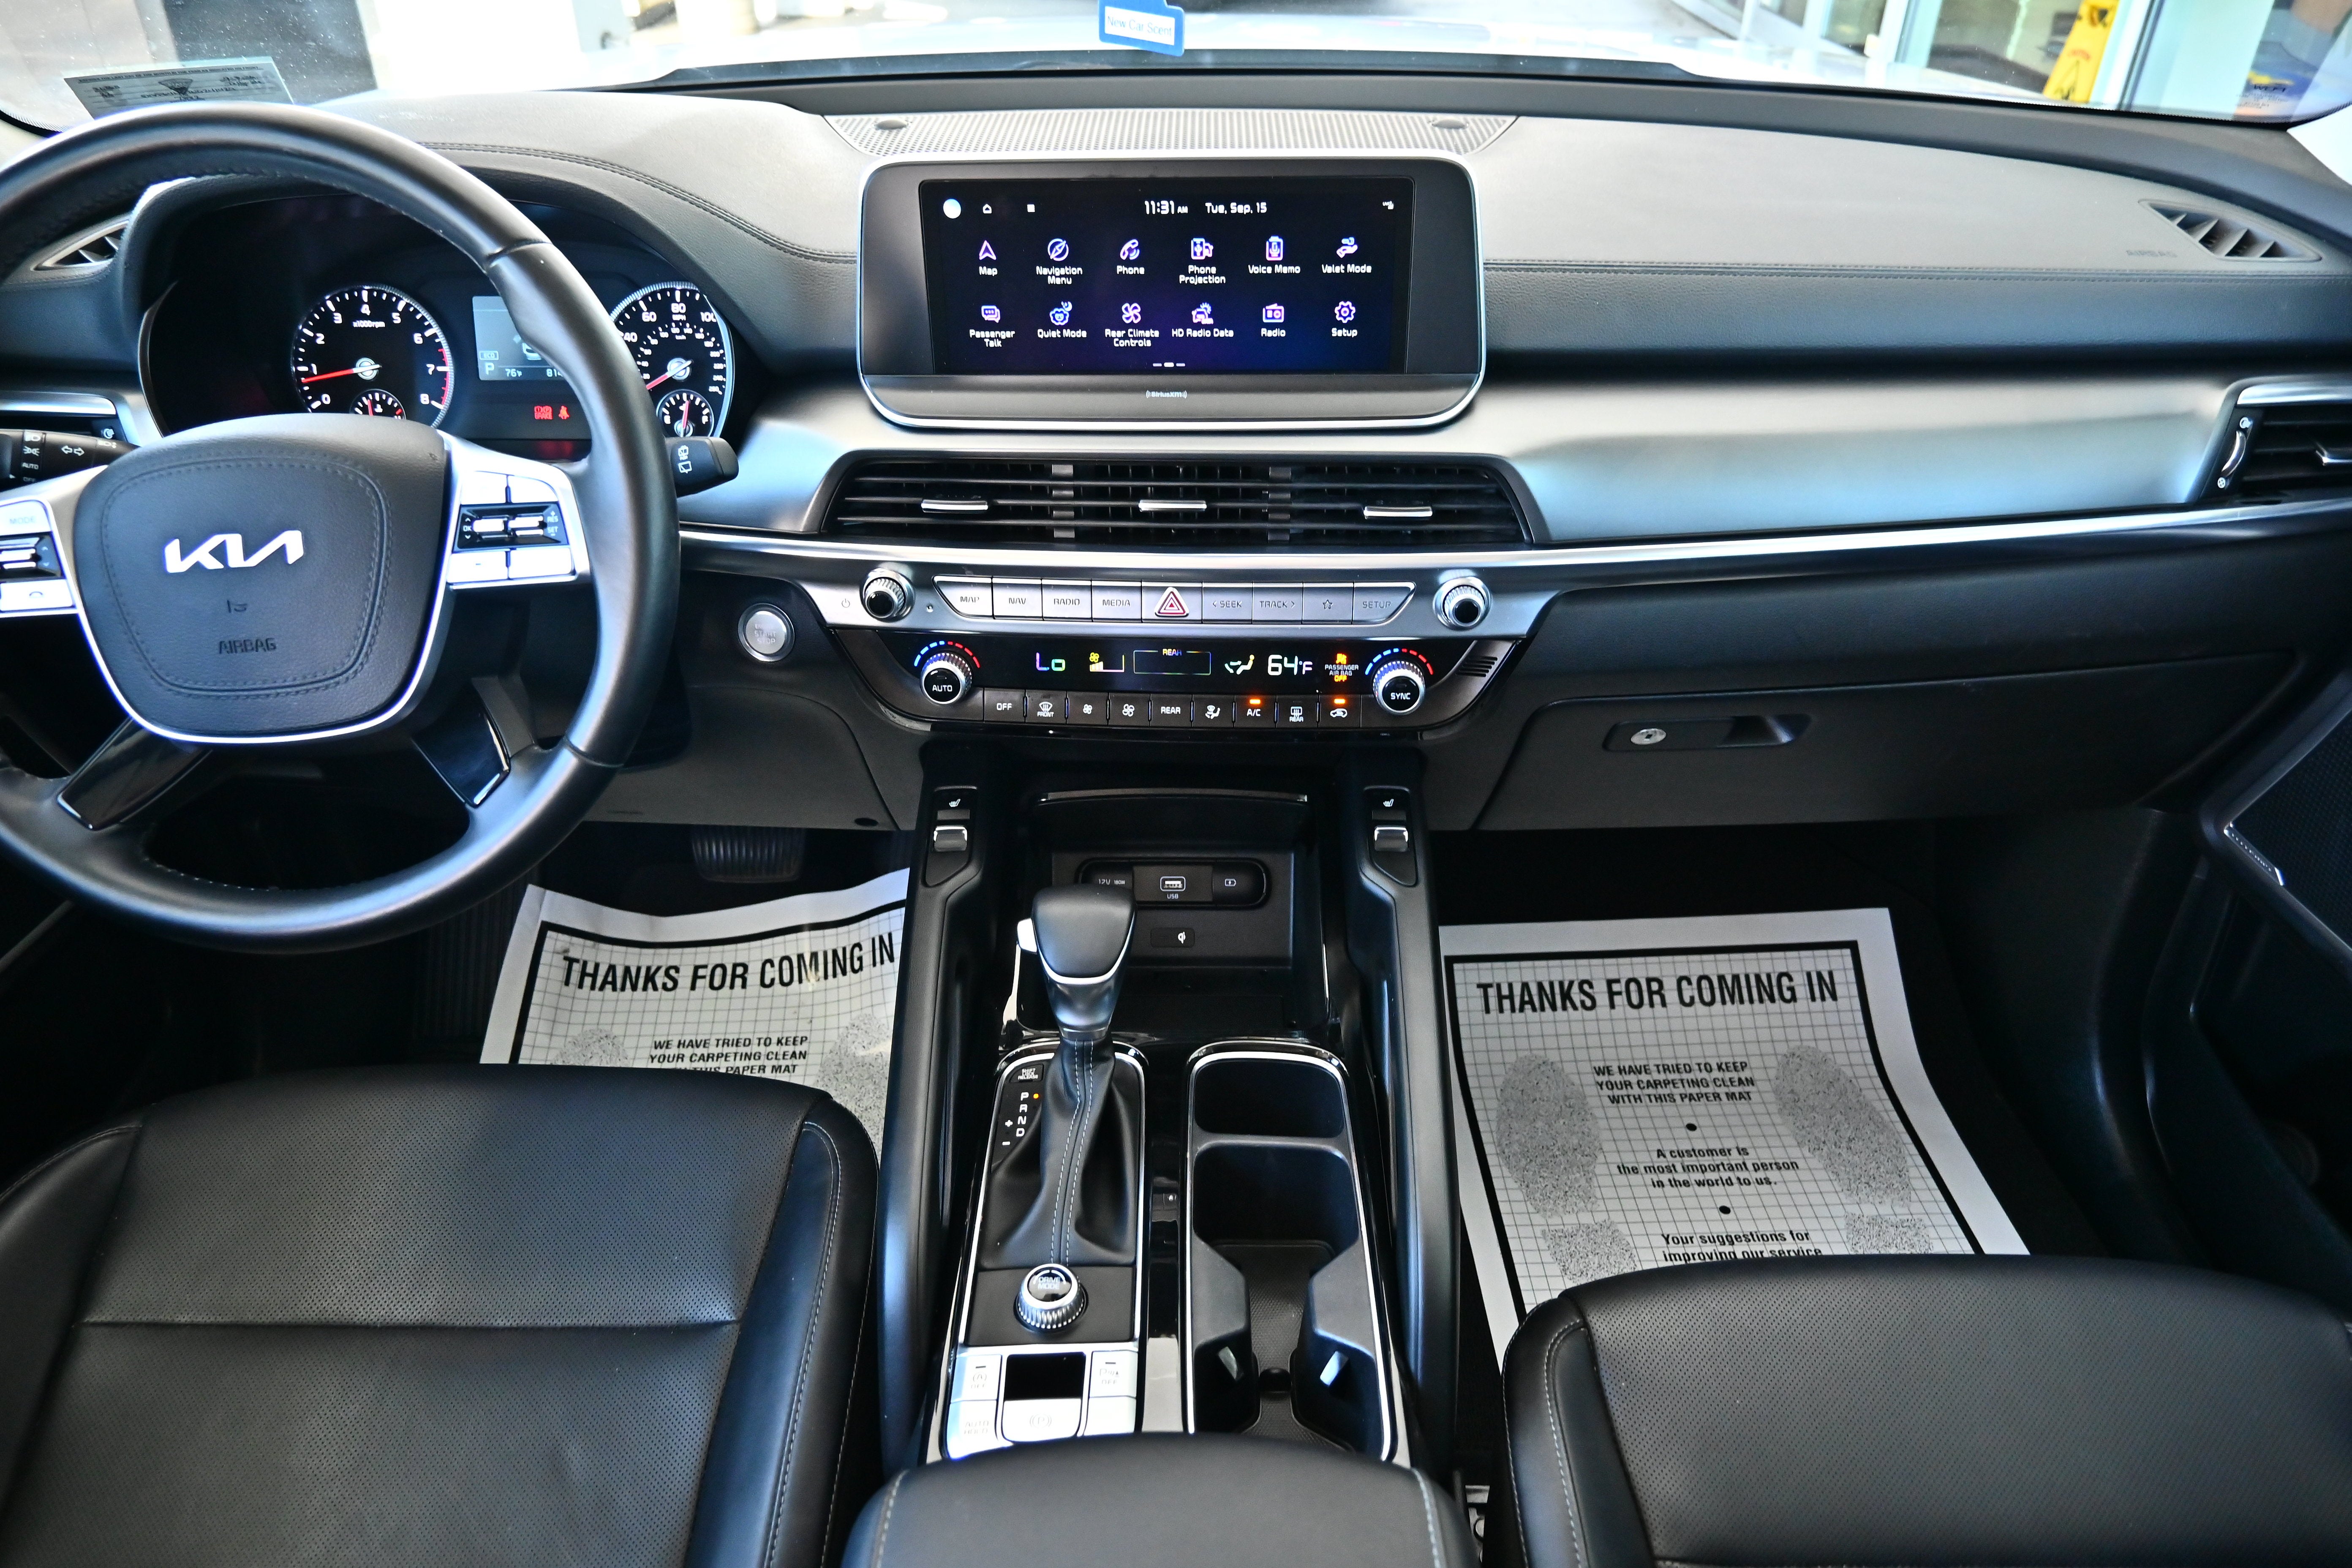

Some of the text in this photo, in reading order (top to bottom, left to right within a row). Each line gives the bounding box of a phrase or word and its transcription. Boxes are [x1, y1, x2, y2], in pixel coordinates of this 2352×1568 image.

[1107, 15, 1173, 37] New Car Scent
[1144, 200, 1175, 215] 11:31
[1205, 202, 1267, 215] Tue, Sep. 15
[979, 266, 998, 277] Map
[1036, 266, 1083, 276] Navigation
[1116, 265, 1145, 275] Phone
[1188, 264, 1217, 274] Phone
[1248, 264, 1301, 274] Voice Memo
[1321, 264, 1372, 273] Valet Mode
[1048, 275, 1072, 285] Menu
[1179, 275, 1226, 285] Projection
[360, 304, 371, 316] 4
[671, 303, 686, 313] 80
[333, 313, 342, 324] 3
[392, 312, 401, 324] 5
[642, 312, 657, 322] 60
[352, 320, 385, 329] x1000rpm
[413, 332, 423, 344] 6
[623, 332, 638, 343] 40
[969, 329, 1015, 339] Passenger
[1037, 329, 1087, 339] Quiet Mode
[1105, 328, 1160, 338] Rear Climate
[1172, 328, 1234, 338] HD Radio Data
[1261, 328, 1286, 337] Radio
[1331, 327, 1358, 338] Setup
[315, 333, 325, 344] 2
[984, 337, 1003, 347] Talk
[1113, 338, 1152, 347] Controls
[310, 363, 317, 375] 1
[426, 363, 435, 375] 7
[485, 362, 495, 375] P
[321, 394, 331, 405] 0
[419, 393, 430, 405] 8
[10, 516, 35, 524] MODE
[1054, 598, 1080, 606] RADIO
[1102, 599, 1131, 607] MEDIA
[1220, 601, 1242, 609] SEEK
[1259, 600, 1288, 609] TRACK
[1362, 600, 1391, 610] SETUP
[220, 637, 277, 654] AIRBAG
[996, 702, 1012, 710] OFF
[1161, 706, 1181, 714] REAR
[1247, 708, 1261, 716] A/C
[564, 932, 895, 992] THANKS FOR COMING IN
[1477, 970, 1838, 1014] THANKS FOR COMING IN
[654, 1036, 808, 1050] WE HAVE TRIED TO KEEP
[650, 1051, 807, 1063] YOUR CARPETING CLEAN
[726, 1065, 765, 1075] PAPER
[771, 1064, 798, 1074] MAT
[1594, 1061, 1748, 1076] WE HAVE TRIED TO KEEP
[1596, 1076, 1755, 1091] YOUR CARPETING CLEAN
[1021, 1092, 1029, 1101] P
[1608, 1091, 1753, 1105] WITH THIS PAPER MAT
[1017, 1116, 1026, 1125] N
[1016, 1128, 1025, 1137] D
[1657, 1146, 1749, 1159] A customer is
[1617, 1160, 1799, 1175] the most important person
[1651, 1175, 1778, 1188] in the world to us.
[1661, 1230, 1810, 1246] Your suggestions for
[1662, 1246, 1822, 1263] improving our service
